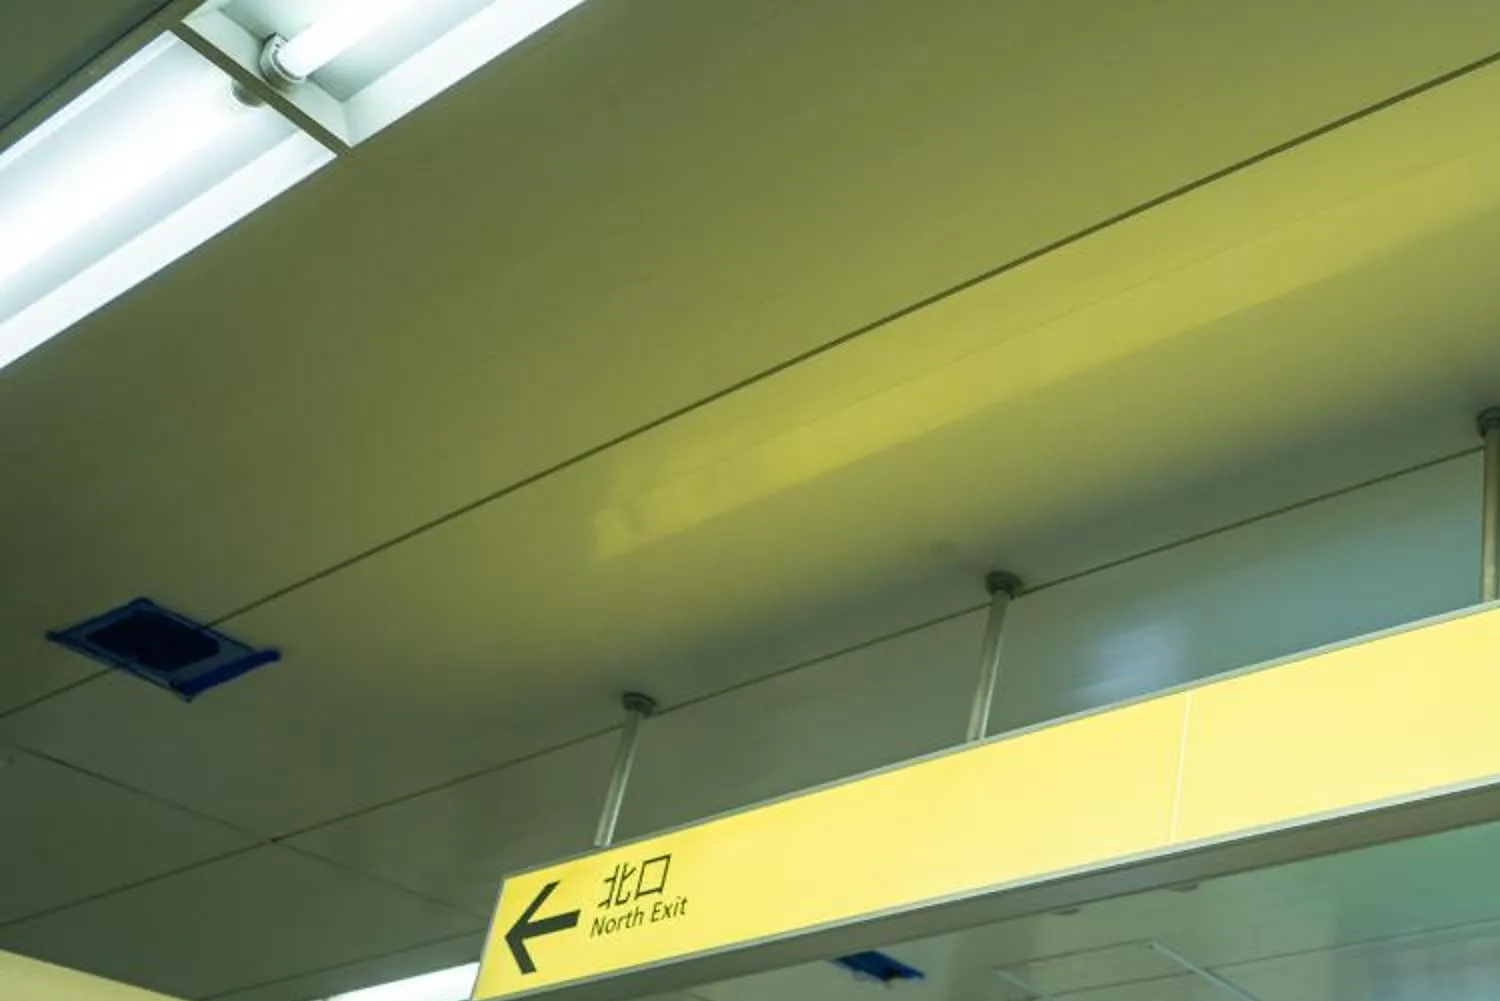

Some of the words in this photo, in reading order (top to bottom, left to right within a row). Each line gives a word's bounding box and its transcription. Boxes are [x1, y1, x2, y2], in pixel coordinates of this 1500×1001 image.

[599, 854, 672, 909] 北口
[591, 907, 645, 937] North
[651, 897, 688, 923] Exit
